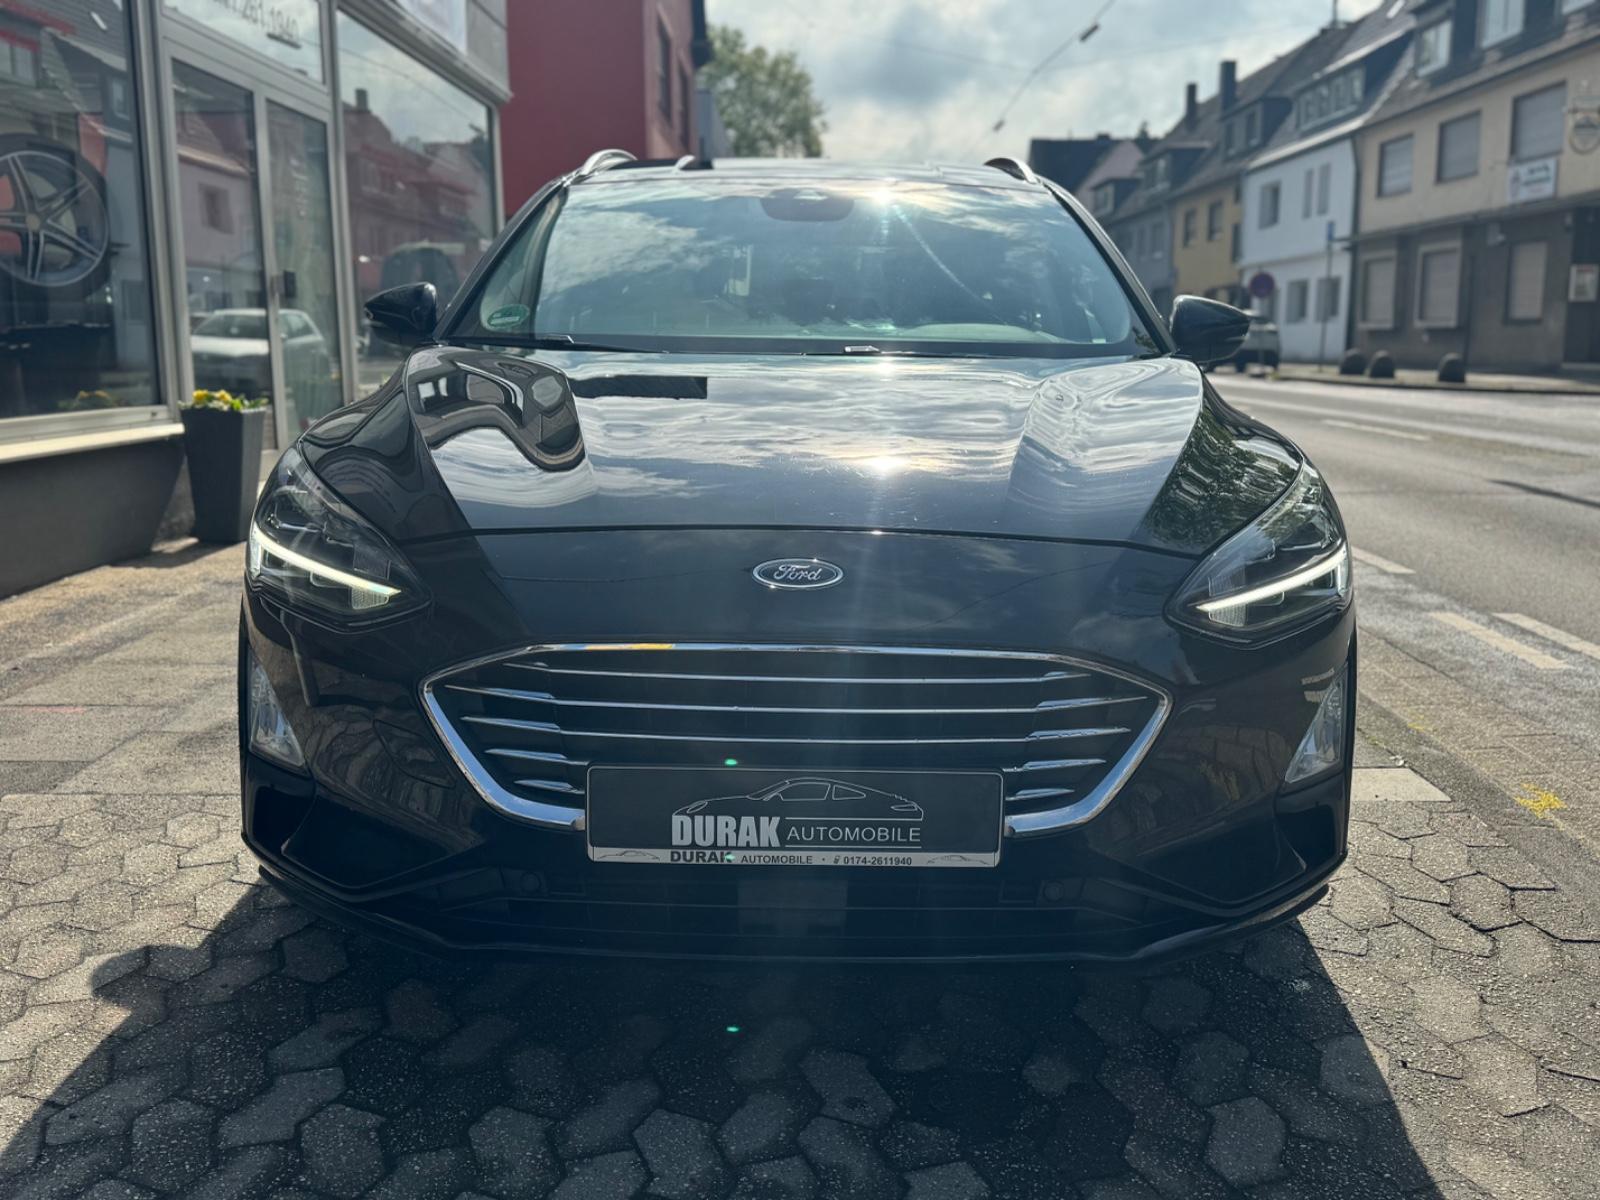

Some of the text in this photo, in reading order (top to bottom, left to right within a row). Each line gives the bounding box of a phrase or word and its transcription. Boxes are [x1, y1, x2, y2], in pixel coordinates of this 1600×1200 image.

[773, 563, 822, 581] Ford
[671, 815, 921, 848] DURAK AUTOMOBILE
[741, 855, 813, 865] AUTOMOBILE
[843, 856, 912, 866] 0174-2611940
